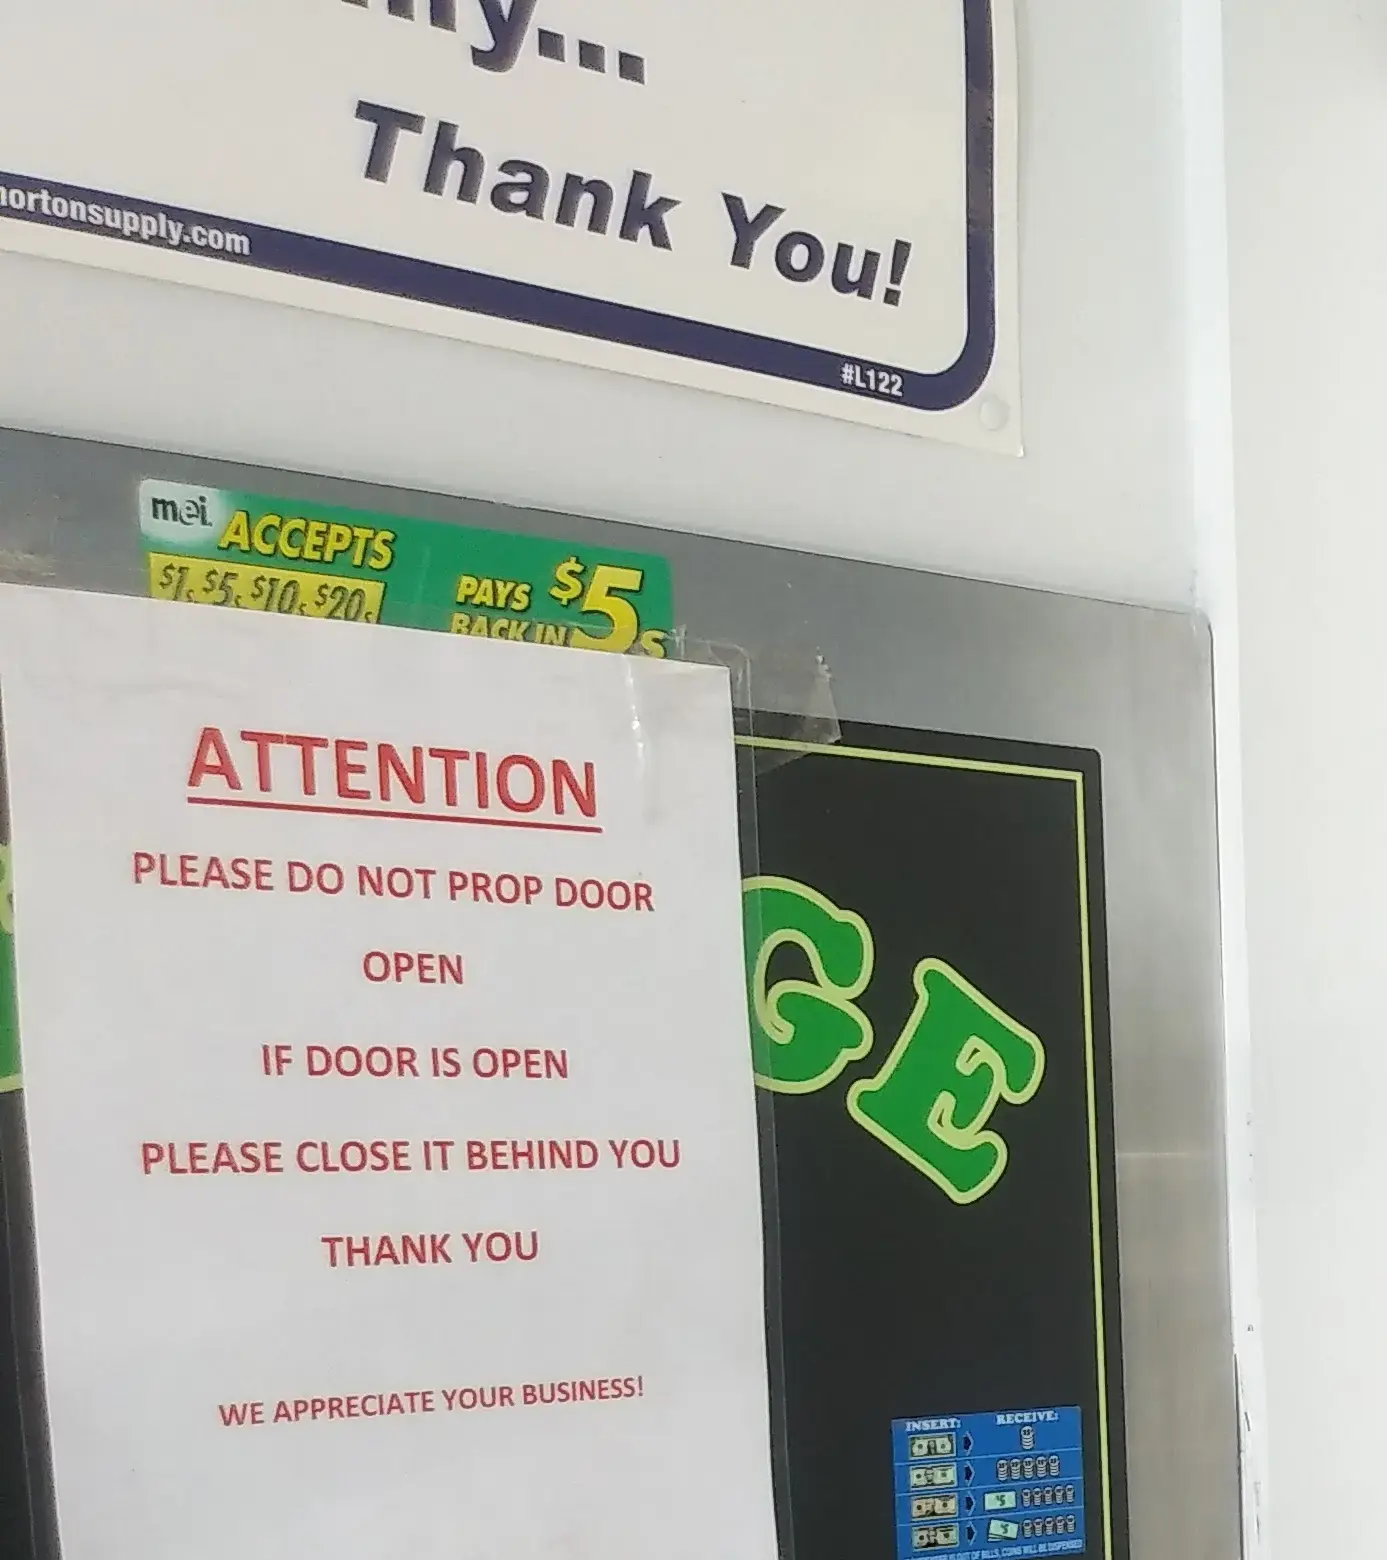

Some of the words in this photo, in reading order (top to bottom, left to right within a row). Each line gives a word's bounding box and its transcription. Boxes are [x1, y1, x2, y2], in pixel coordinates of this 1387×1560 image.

[354, 100, 683, 252] Thank
[718, 193, 912, 306] You!
[840, 363, 904, 397] #L122
[218, 509, 396, 571] ACCEPTS
[455, 573, 533, 612] PAYS
[450, 611, 531, 642] BACK
[535, 622, 567, 647] IN
[188, 726, 600, 818] ATTENTION
[133, 852, 274, 892] PLEASE
[287, 861, 343, 896] DO
[358, 866, 436, 901] NOT
[449, 871, 543, 907] PROP
[555, 877, 655, 912] DOOR
[362, 950, 464, 985] OPEN
[261, 1043, 293, 1077] IF
[307, 1044, 418, 1078] DOOR
[432, 1046, 461, 1078] IS
[473, 1048, 569, 1079] OPEN
[142, 1141, 284, 1175] PLEASE
[296, 1140, 412, 1174] CLOSE
[423, 1140, 455, 1171] IT
[467, 1140, 599, 1171] BEHIND
[609, 1138, 682, 1170] YOU
[321, 1234, 452, 1268] THANK
[462, 1231, 540, 1264] YOU
[219, 1402, 265, 1427] WE
[273, 1390, 435, 1424] APPRECIATE
[442, 1383, 516, 1412] YOUR
[522, 1375, 645, 1407] BUSINESS!
[905, 1417, 962, 1432] INSERT:
[996, 1409, 1059, 1426] RECEIVE:
